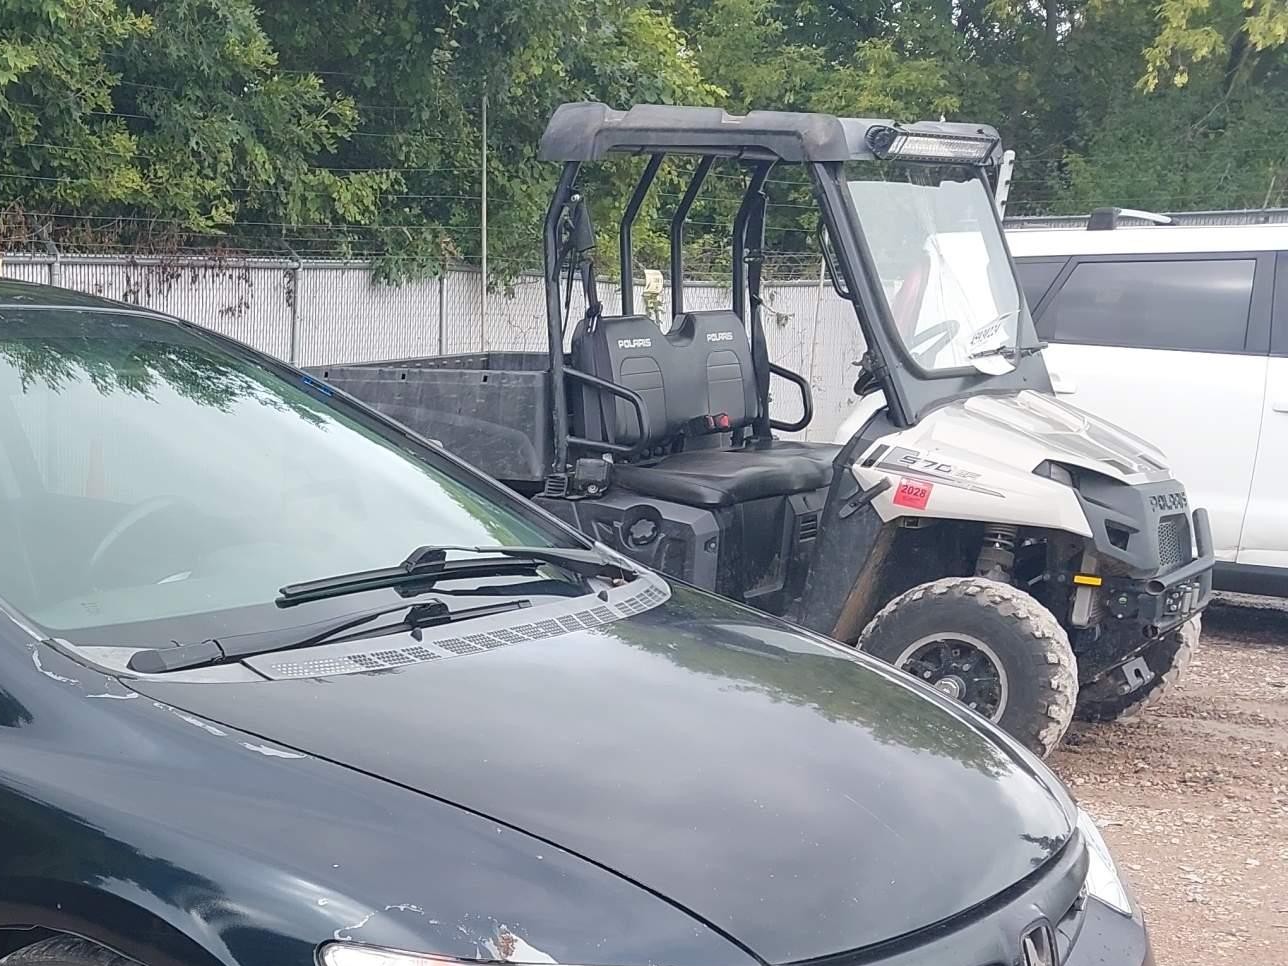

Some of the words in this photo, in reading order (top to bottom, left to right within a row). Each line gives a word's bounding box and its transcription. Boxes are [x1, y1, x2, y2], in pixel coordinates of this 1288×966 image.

[618, 338, 652, 348] POLARIS
[706, 332, 733, 342] POLARIS
[899, 455, 953, 473] 570
[901, 484, 928, 498] 2028
